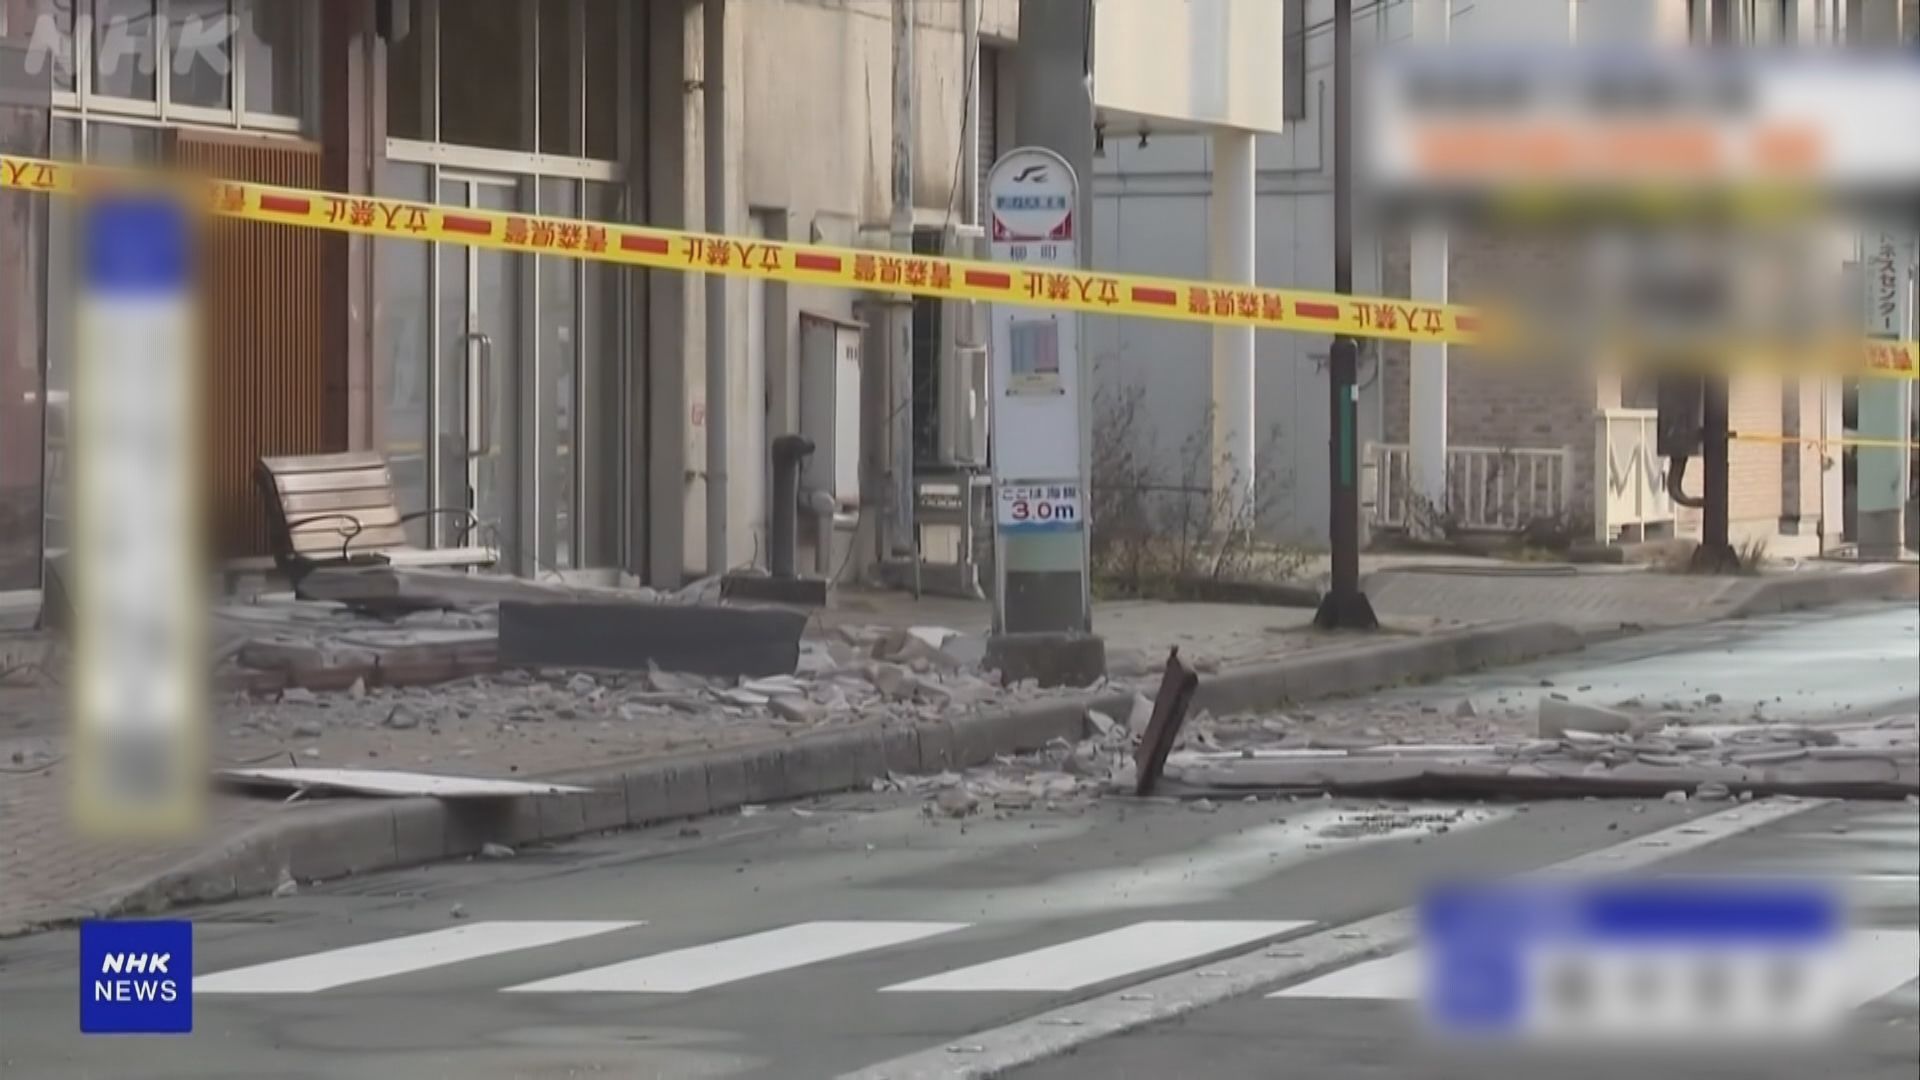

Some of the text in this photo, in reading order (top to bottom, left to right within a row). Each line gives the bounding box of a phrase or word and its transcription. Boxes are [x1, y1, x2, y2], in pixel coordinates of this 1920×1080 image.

[323, 195, 430, 234] 立入禁止
[502, 216, 608, 254] 青森県警
[680, 236, 783, 272] 立入禁止
[853, 254, 953, 290] 青森県警
[1021, 270, 1120, 306] 立入禁止
[1188, 287, 1283, 322] 青森県警
[1350, 301, 1444, 336] 立入禁止
[1011, 500, 1075, 521] 3.0m
